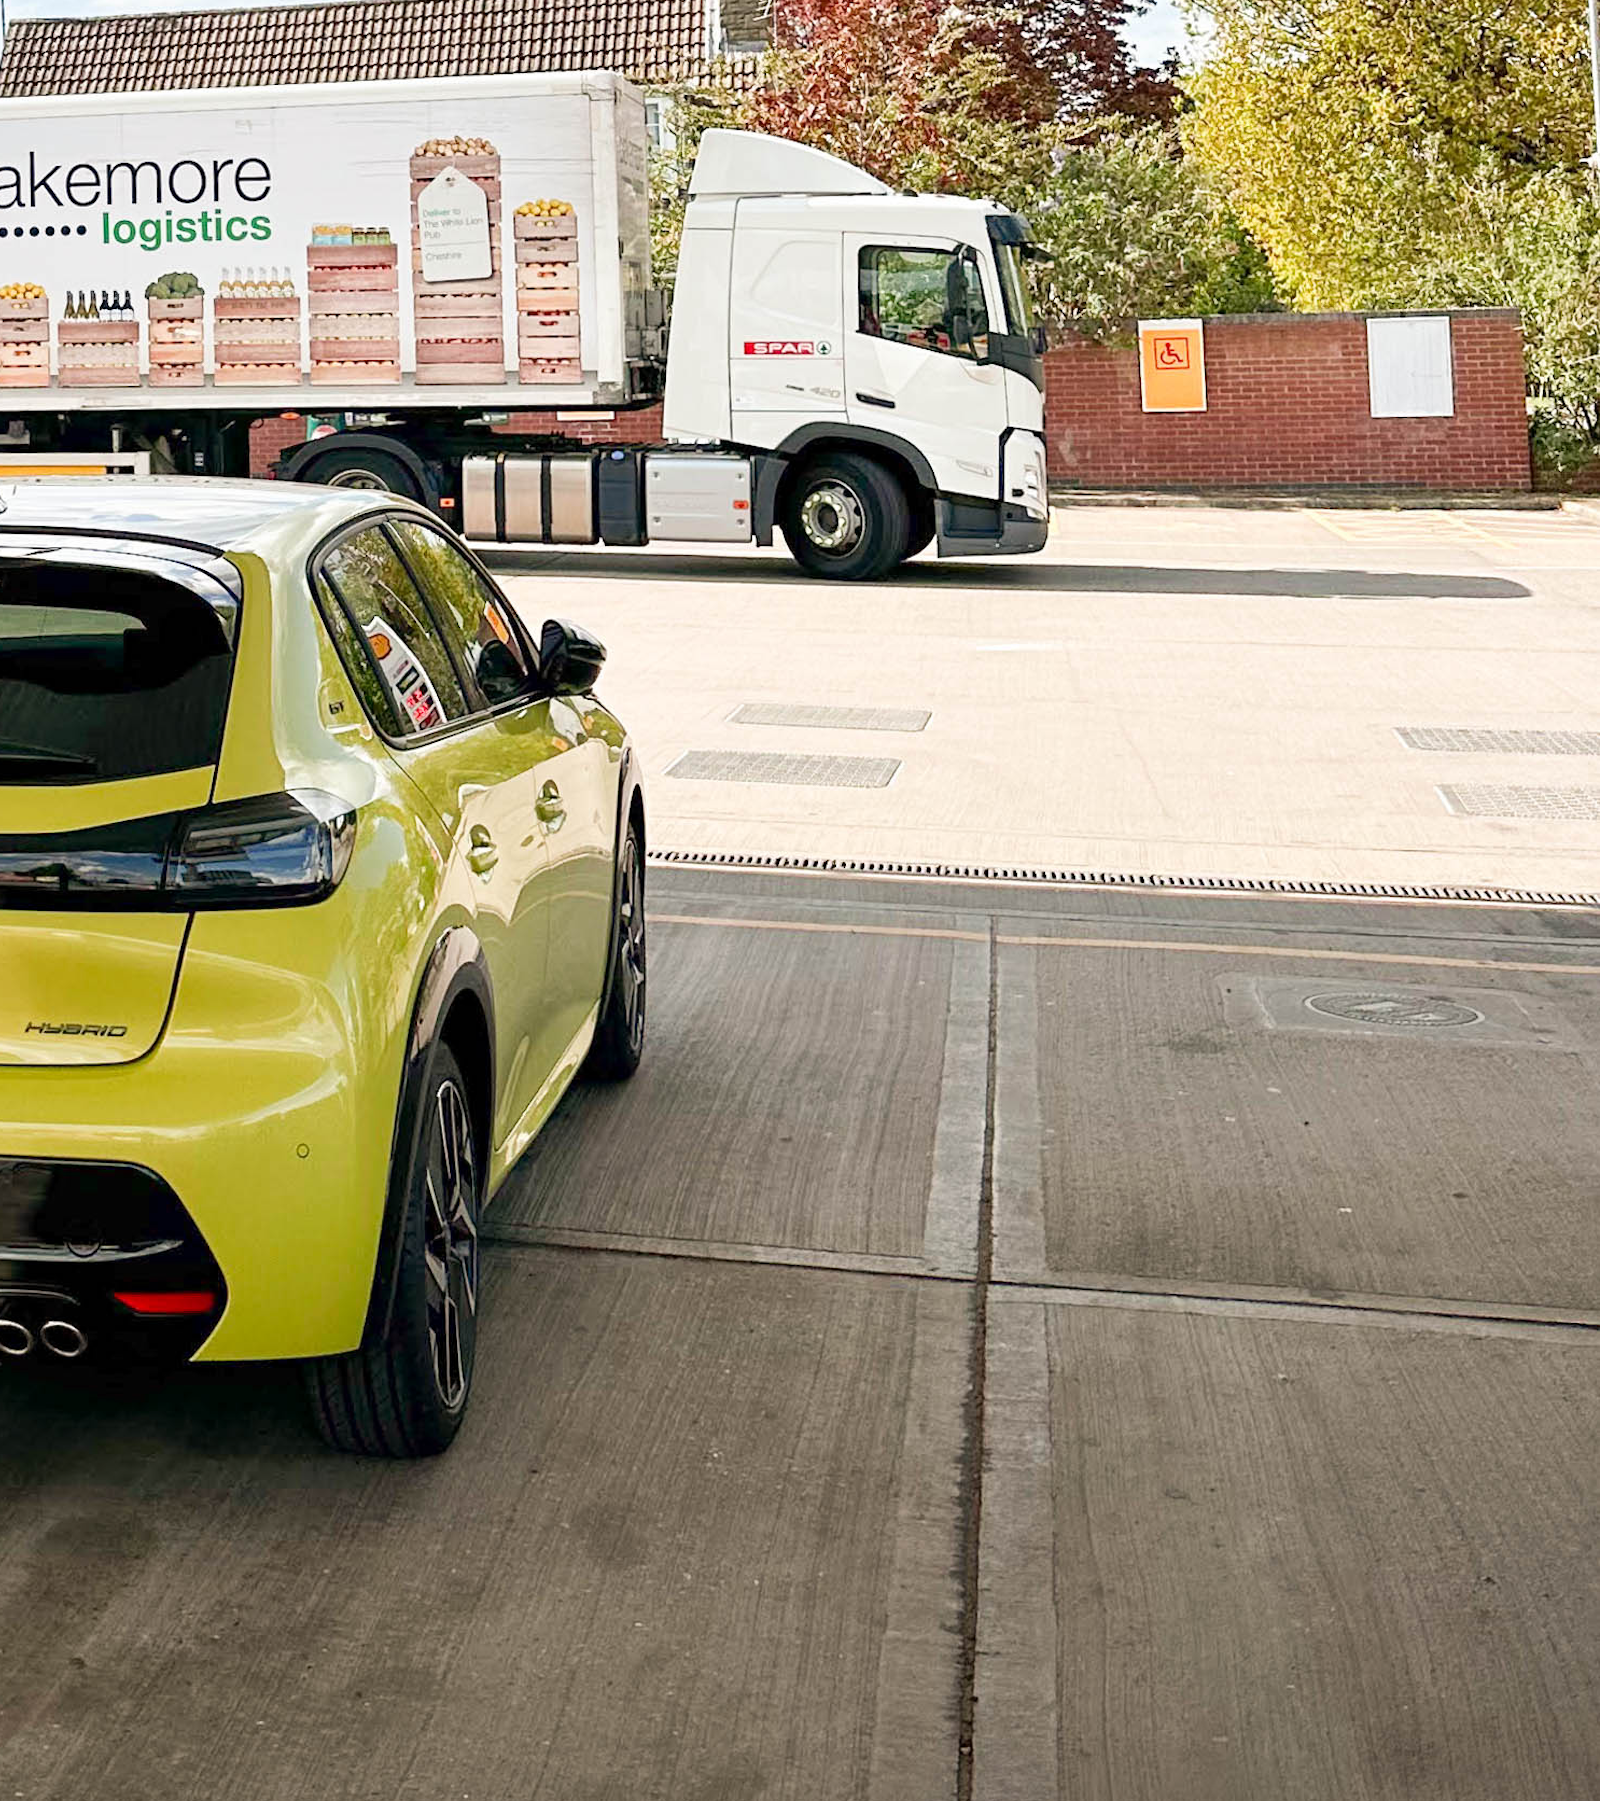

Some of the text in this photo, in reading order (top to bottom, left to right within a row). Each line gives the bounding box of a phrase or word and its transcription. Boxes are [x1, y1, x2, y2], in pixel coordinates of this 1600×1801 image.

[102, 209, 273, 251] logistics
[424, 220, 439, 229] The
[424, 231, 441, 239] Pub
[753, 342, 814, 354] SPAR
[328, 700, 345, 715] GT
[24, 1020, 128, 1038] HYBRID
